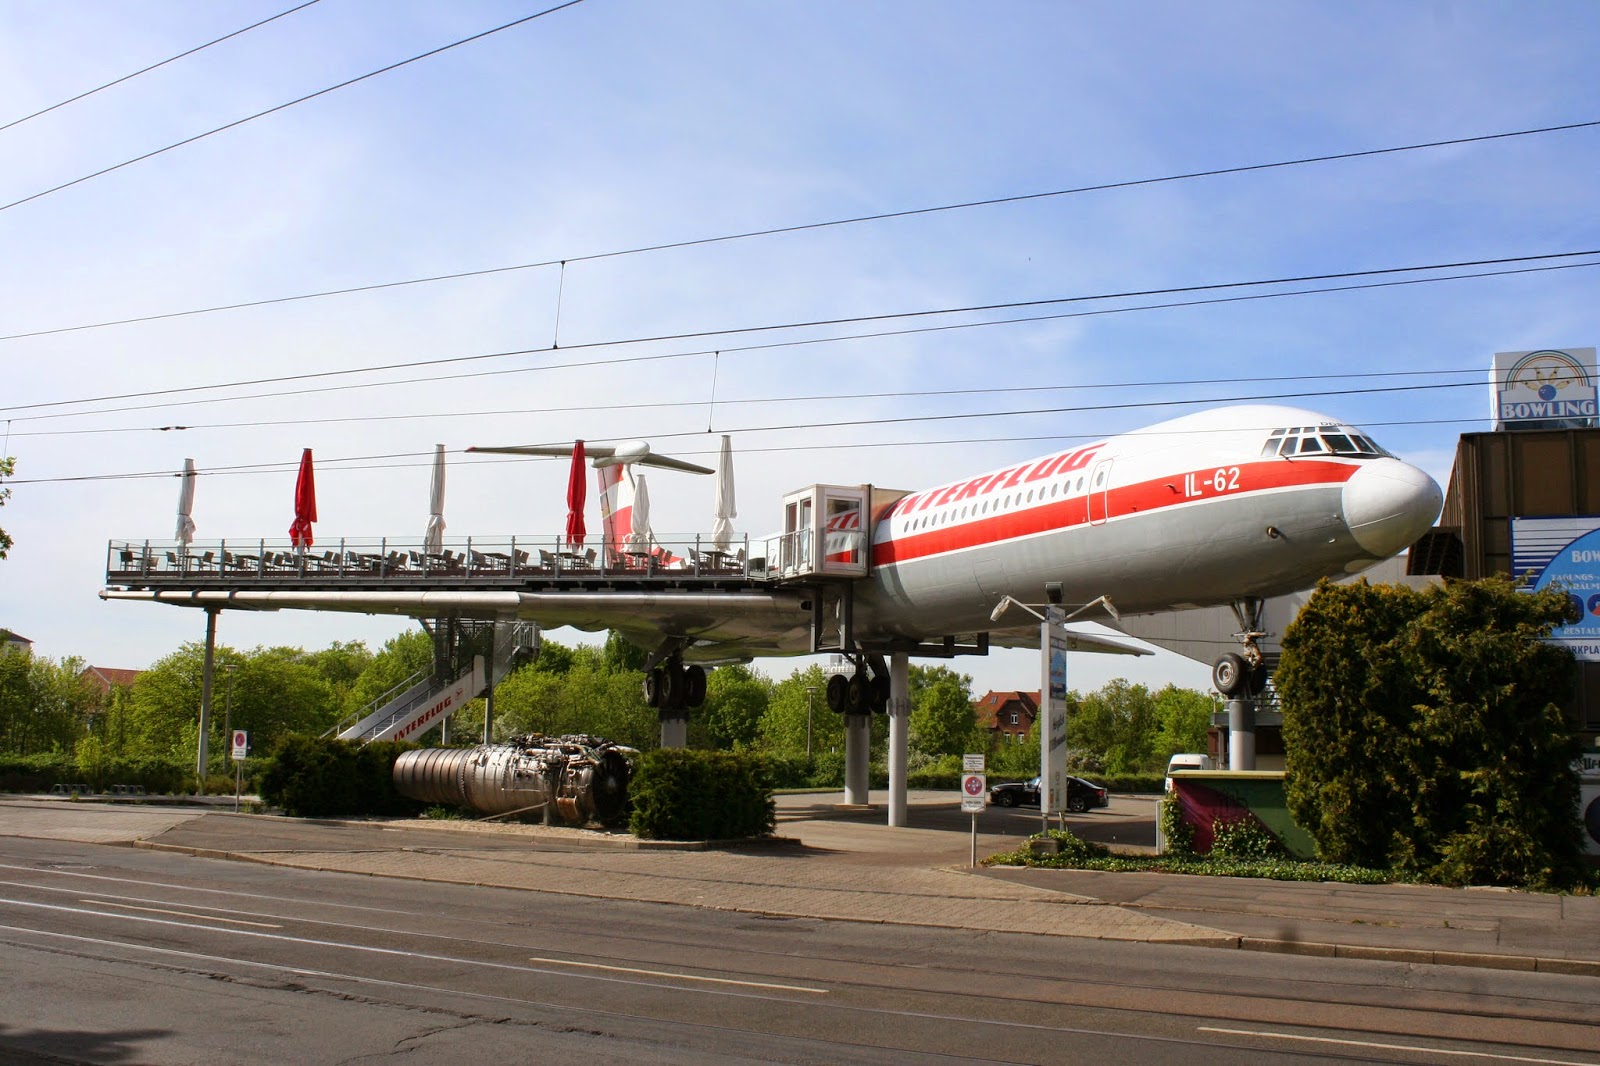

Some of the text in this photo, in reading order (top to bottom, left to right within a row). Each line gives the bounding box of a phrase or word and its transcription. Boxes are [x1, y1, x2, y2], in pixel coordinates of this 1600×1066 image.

[1501, 400, 1595, 419] BOWLING
[882, 442, 1108, 520] INTERFLUG
[1184, 466, 1240, 498] IL-62
[394, 696, 451, 742] INTERFLUG
